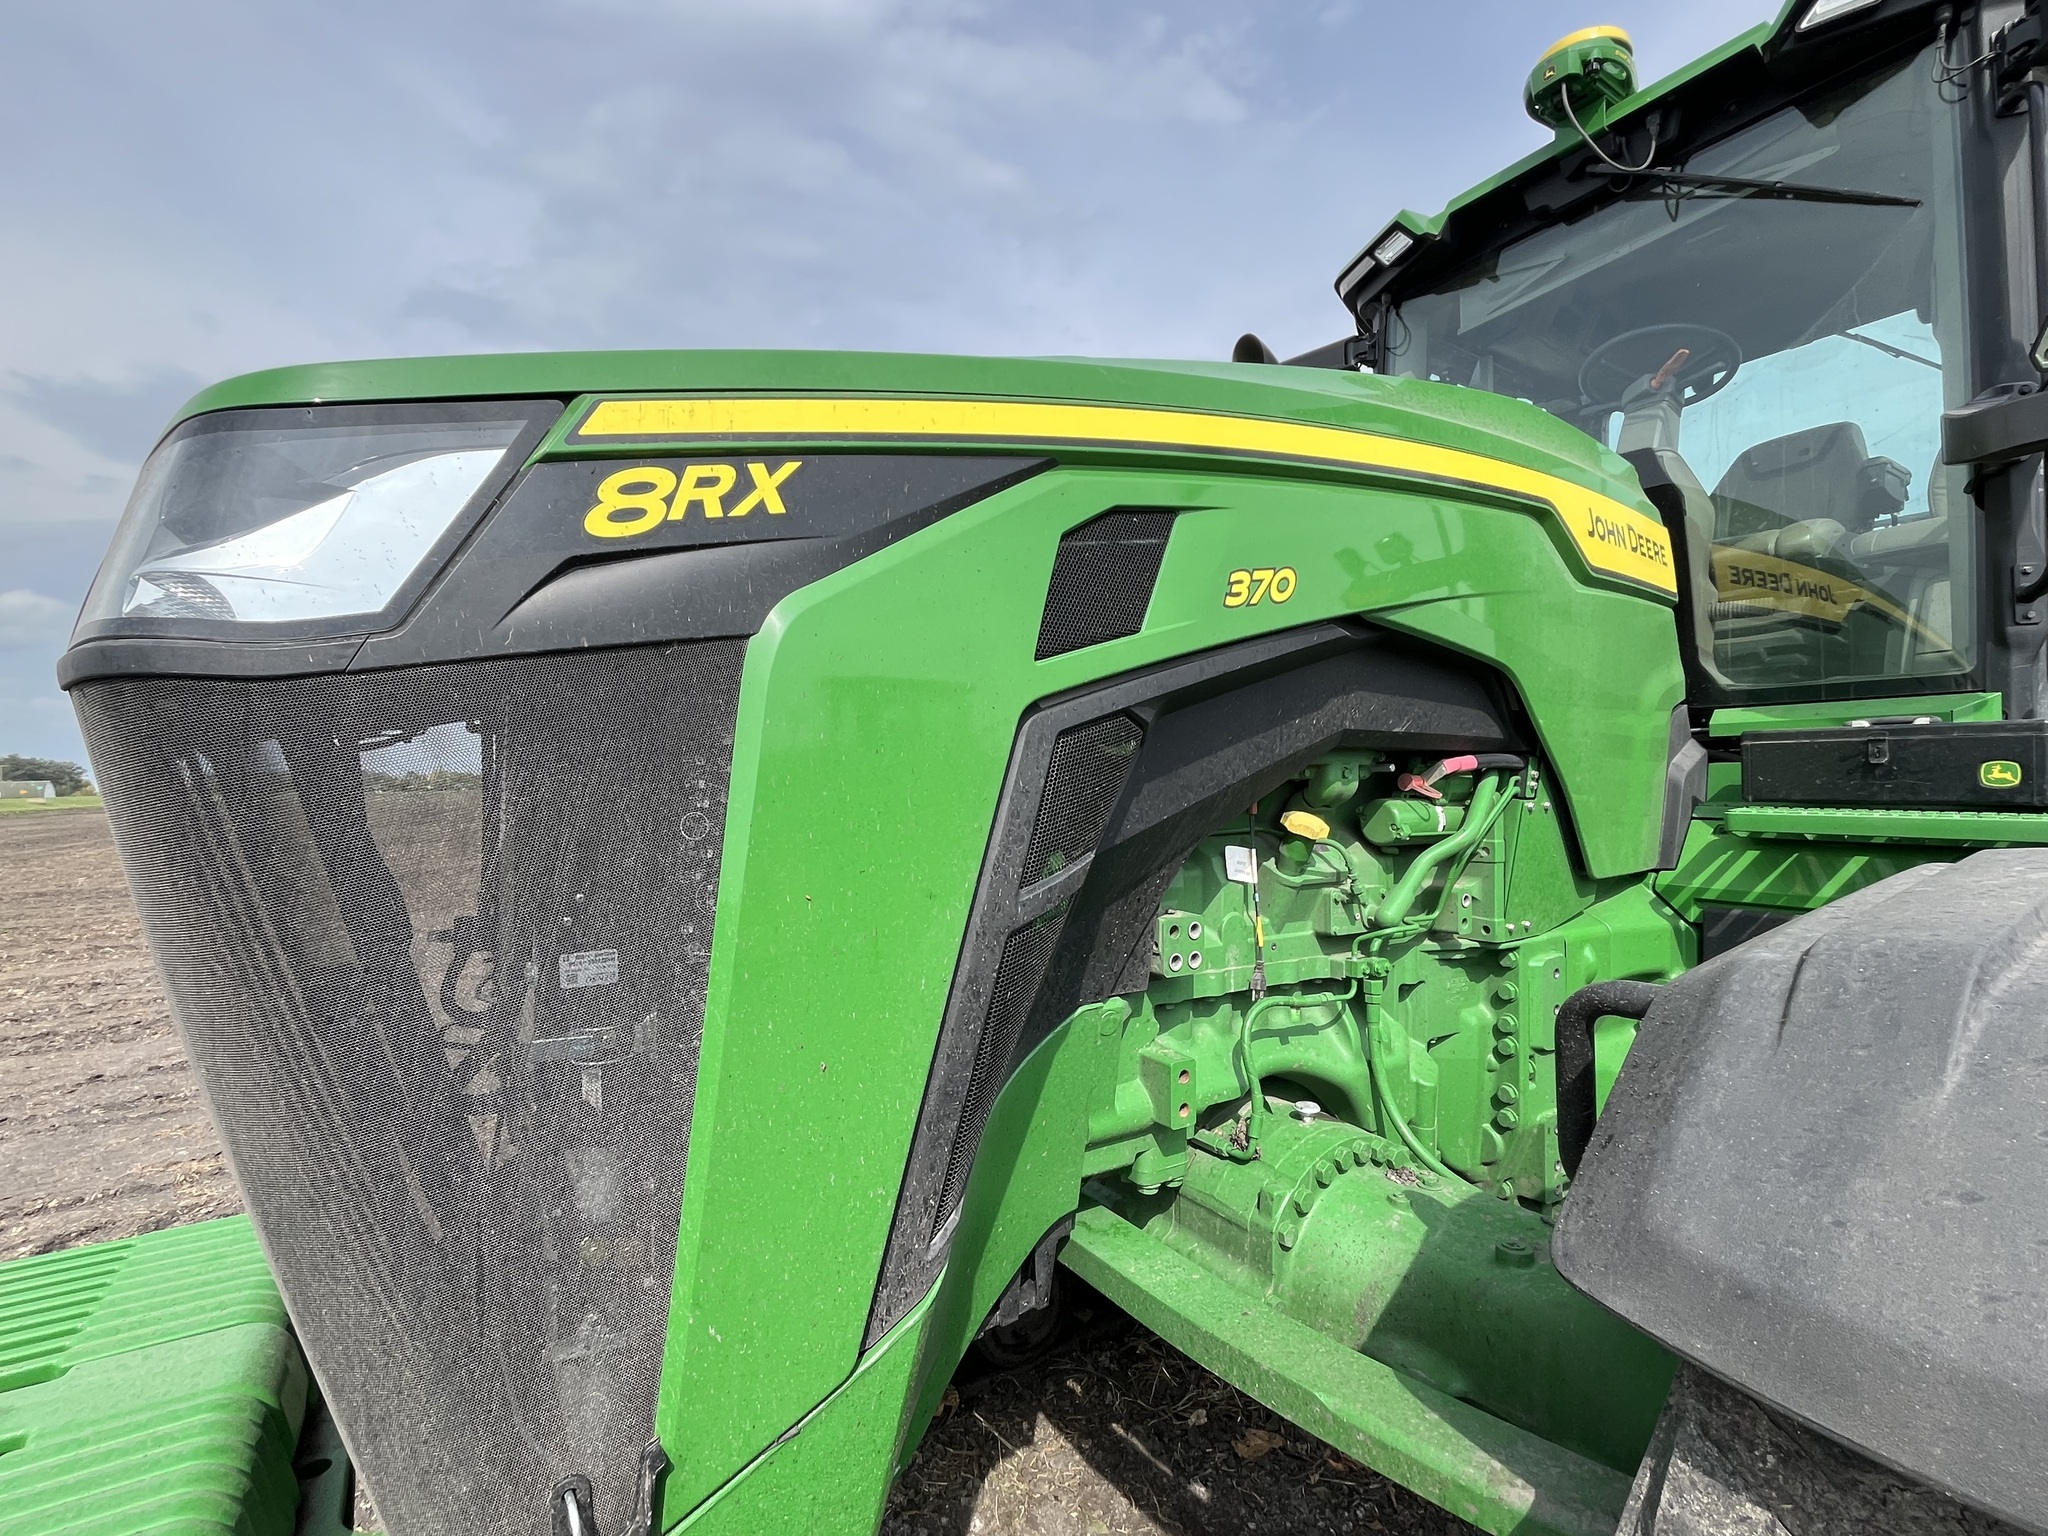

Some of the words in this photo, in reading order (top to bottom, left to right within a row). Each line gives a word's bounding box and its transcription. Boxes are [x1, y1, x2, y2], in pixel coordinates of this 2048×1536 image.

[583, 461, 803, 538] 8RX
[1587, 507, 1627, 550] JOHN
[1626, 523, 1668, 567] DEERE
[1223, 566, 1297, 608] 370
